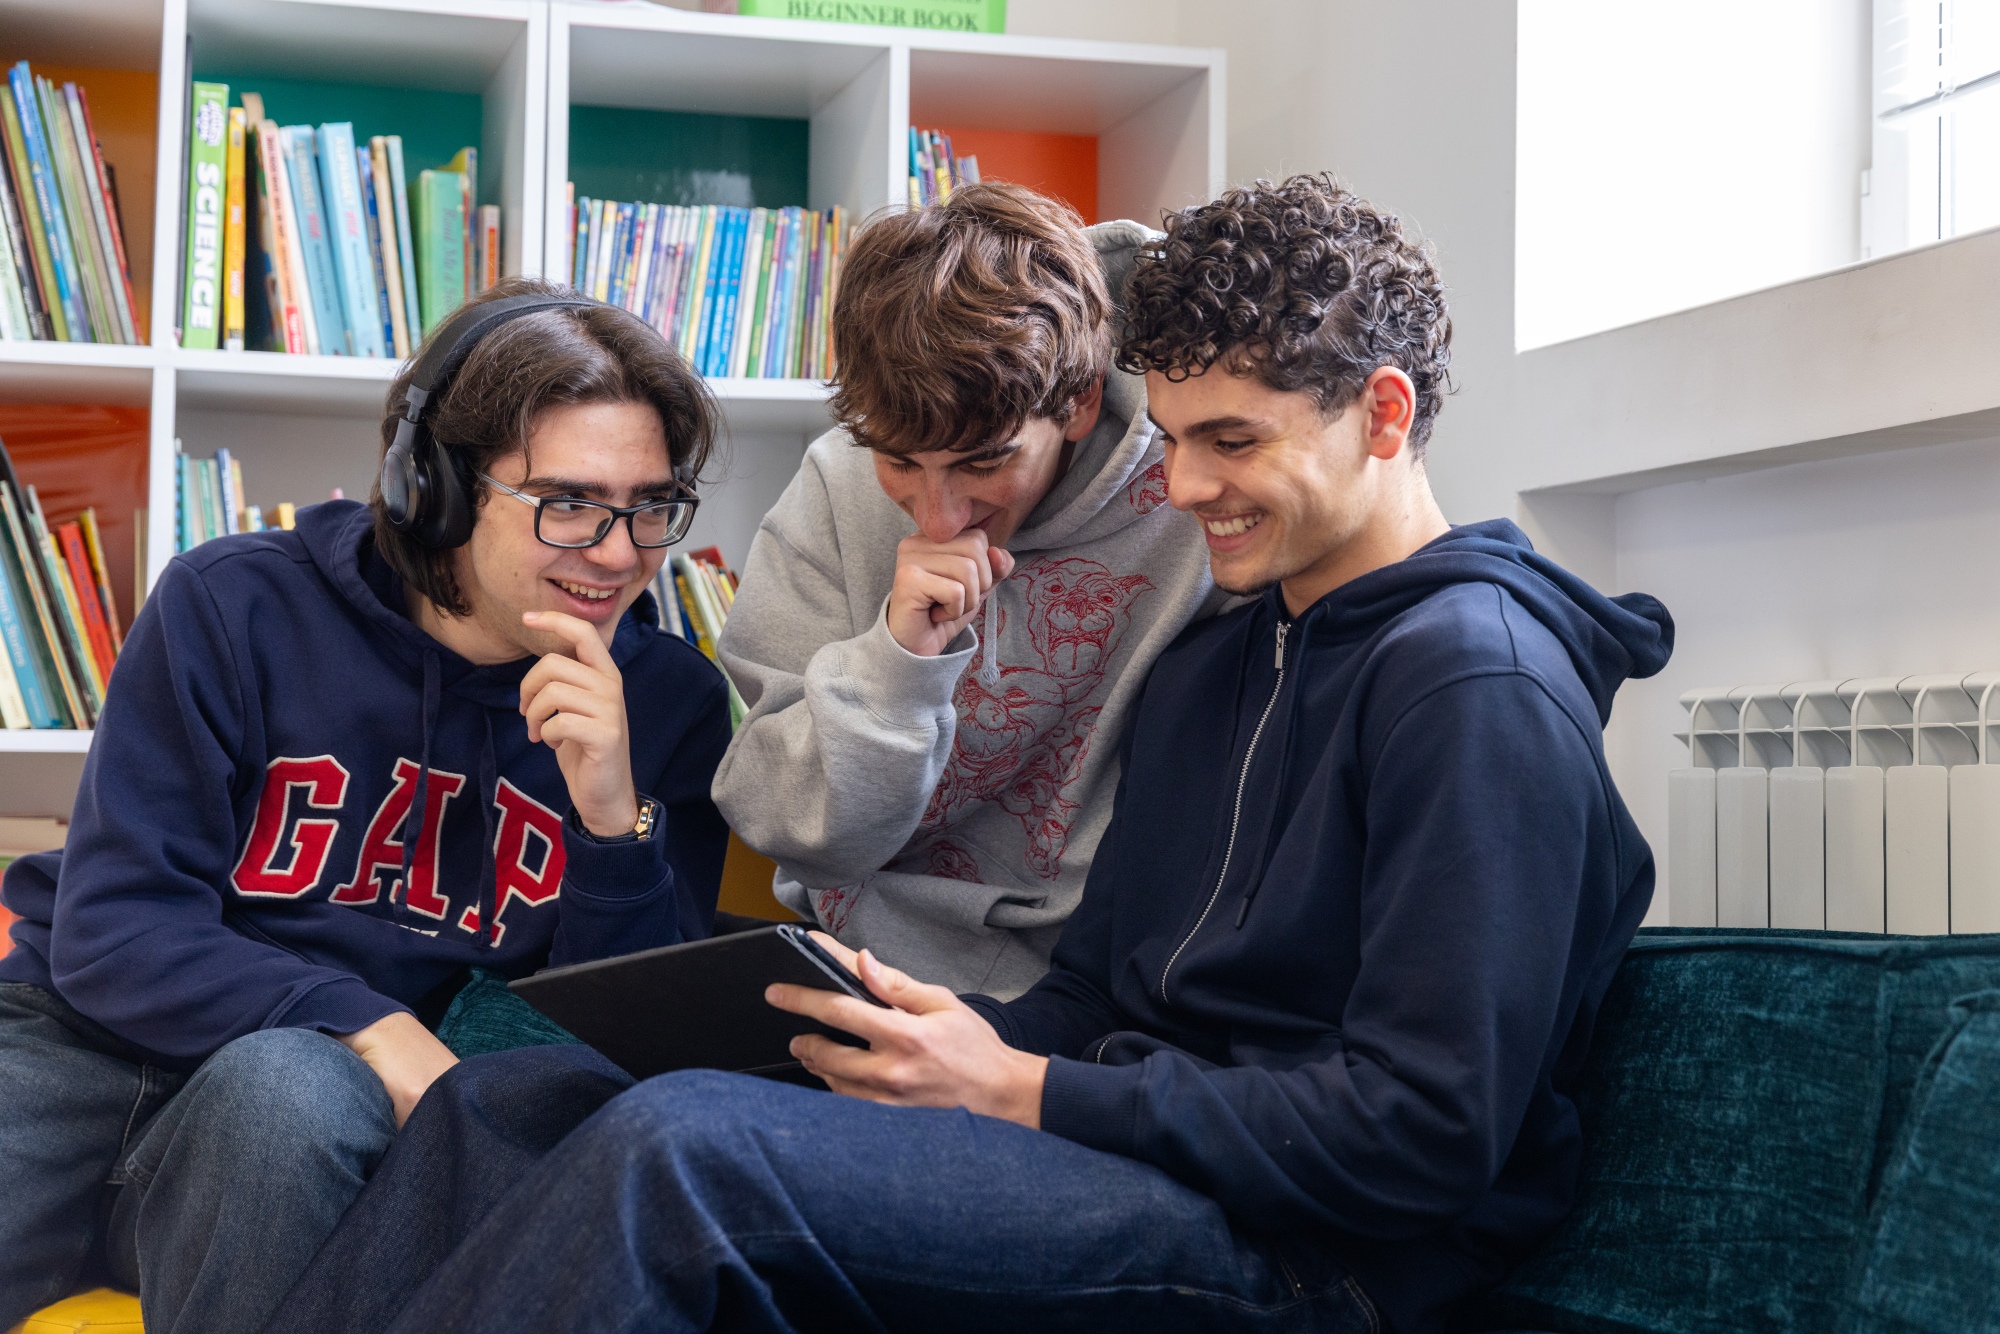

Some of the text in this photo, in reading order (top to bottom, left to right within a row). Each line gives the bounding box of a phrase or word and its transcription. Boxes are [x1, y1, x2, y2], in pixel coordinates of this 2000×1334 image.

[787, 1, 979, 32] BEGINNER BOOK
[190, 162, 220, 329] SCIENCE
[230, 755, 567, 947] GAP
